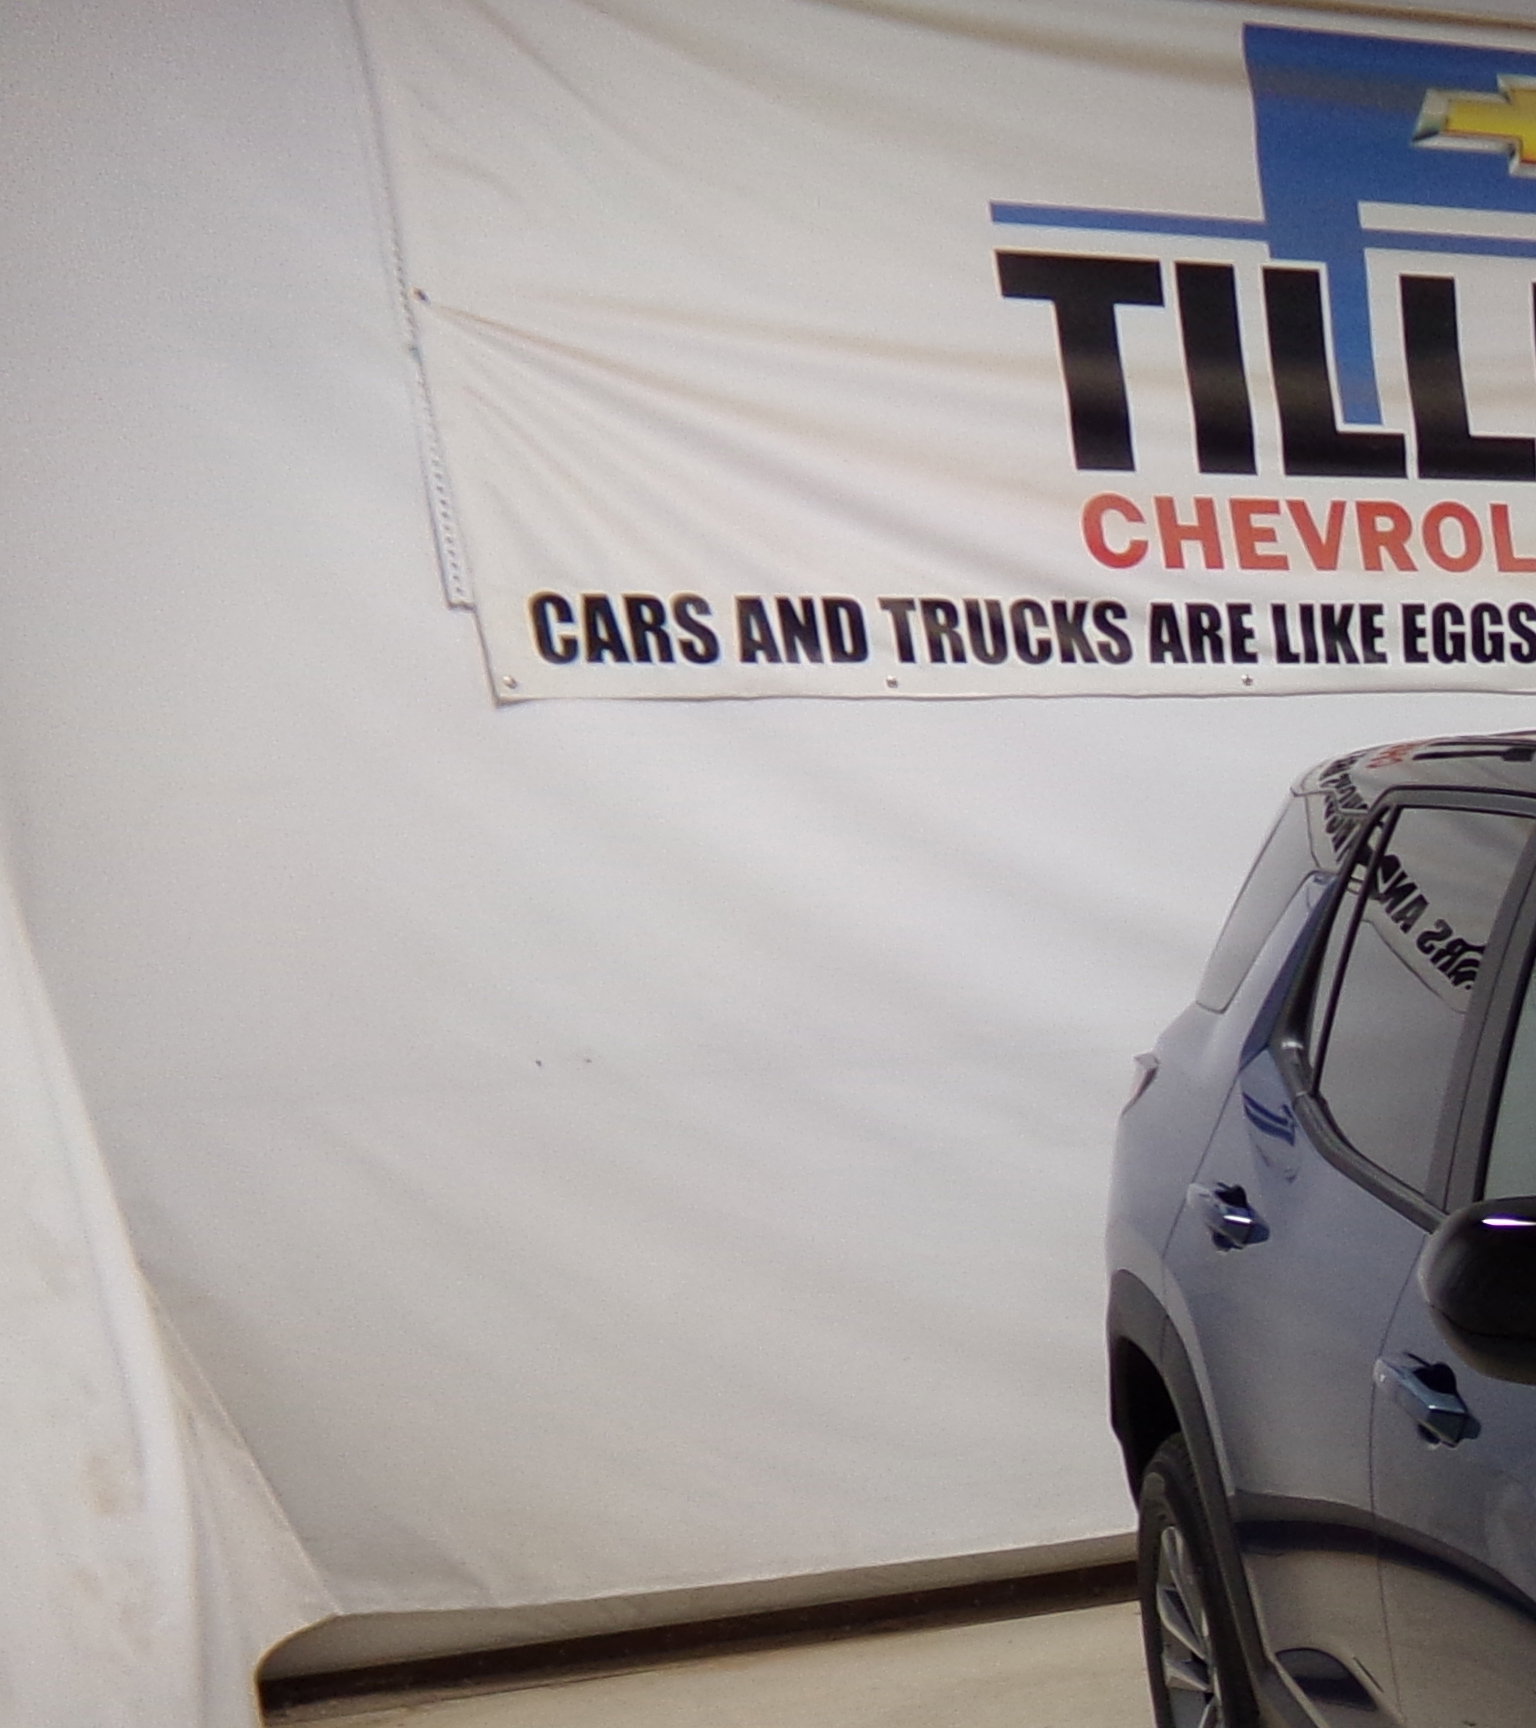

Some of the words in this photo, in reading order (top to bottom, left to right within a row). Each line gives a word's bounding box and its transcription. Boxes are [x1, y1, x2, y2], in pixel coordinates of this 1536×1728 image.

[527, 592, 720, 665] CARS
[733, 596, 869, 665] AND
[878, 597, 1134, 665] TRUCKS
[1149, 602, 1259, 665] ARE
[1273, 602, 1388, 665] LIKE
